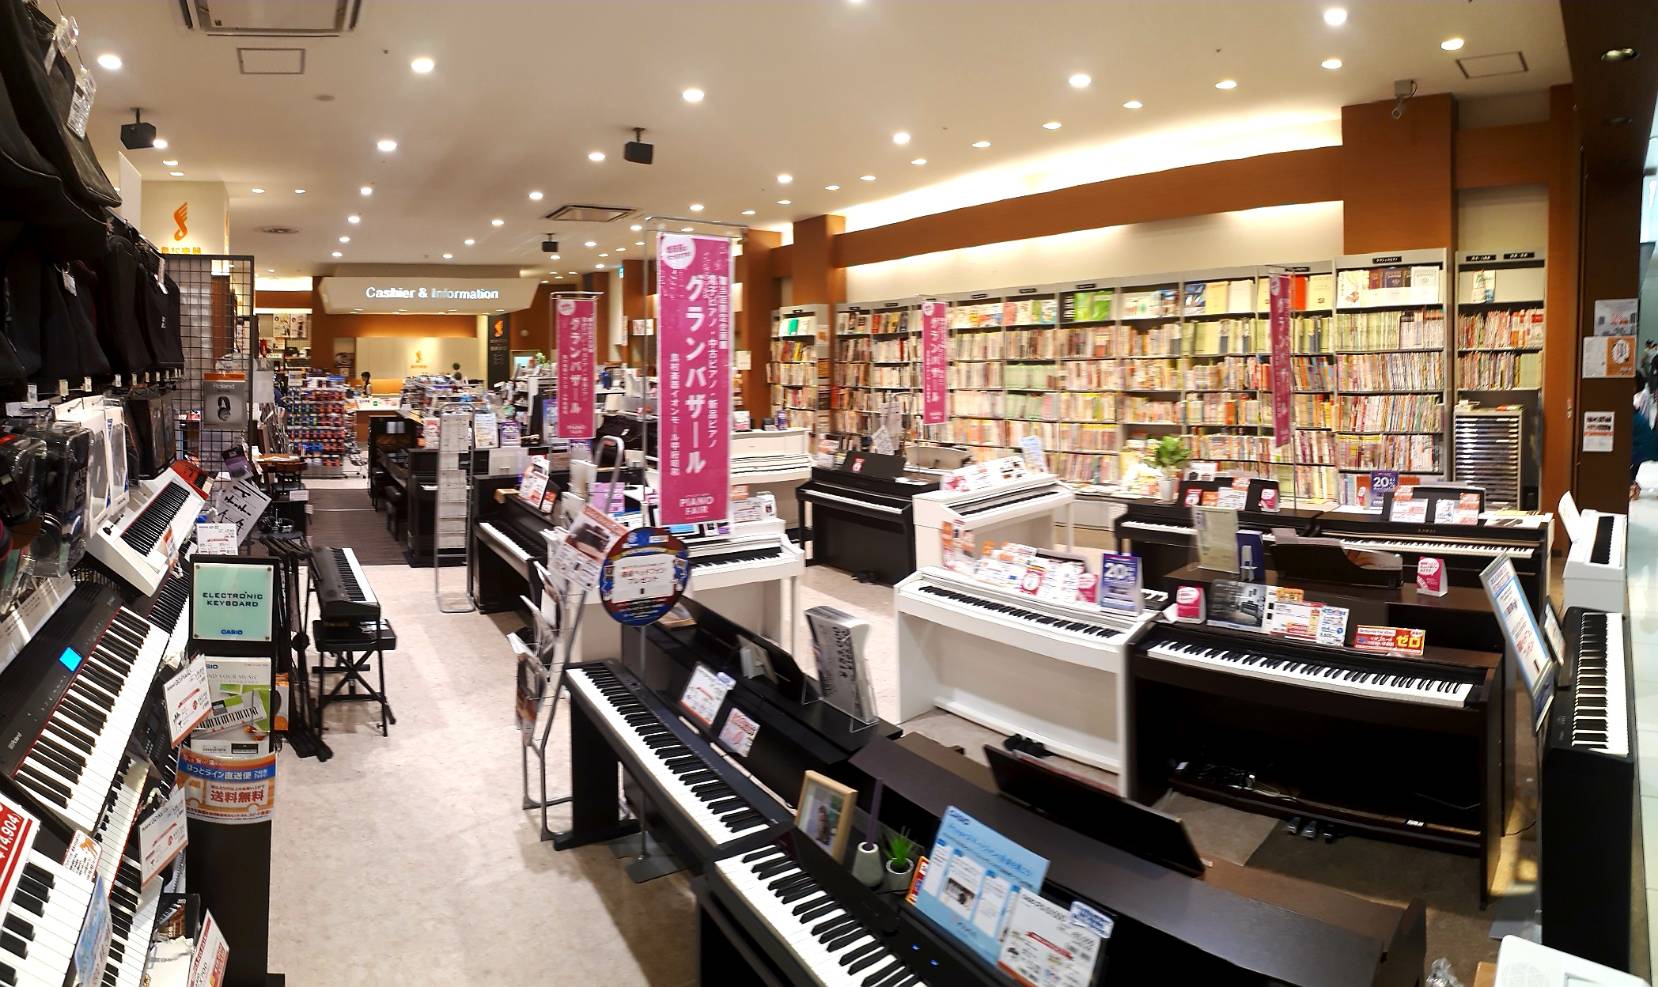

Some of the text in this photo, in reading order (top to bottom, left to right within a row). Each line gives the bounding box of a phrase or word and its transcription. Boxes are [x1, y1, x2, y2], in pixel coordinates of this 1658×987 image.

[366, 287, 499, 299] Cashier & Information
[685, 274, 706, 474] グランバザール
[679, 496, 714, 507] PIANO
[685, 506, 708, 515] FAIR
[202, 592, 263, 600] ELECTRONIC
[1396, 634, 1421, 648] ゼロ
[210, 790, 264, 803] 送料無料
